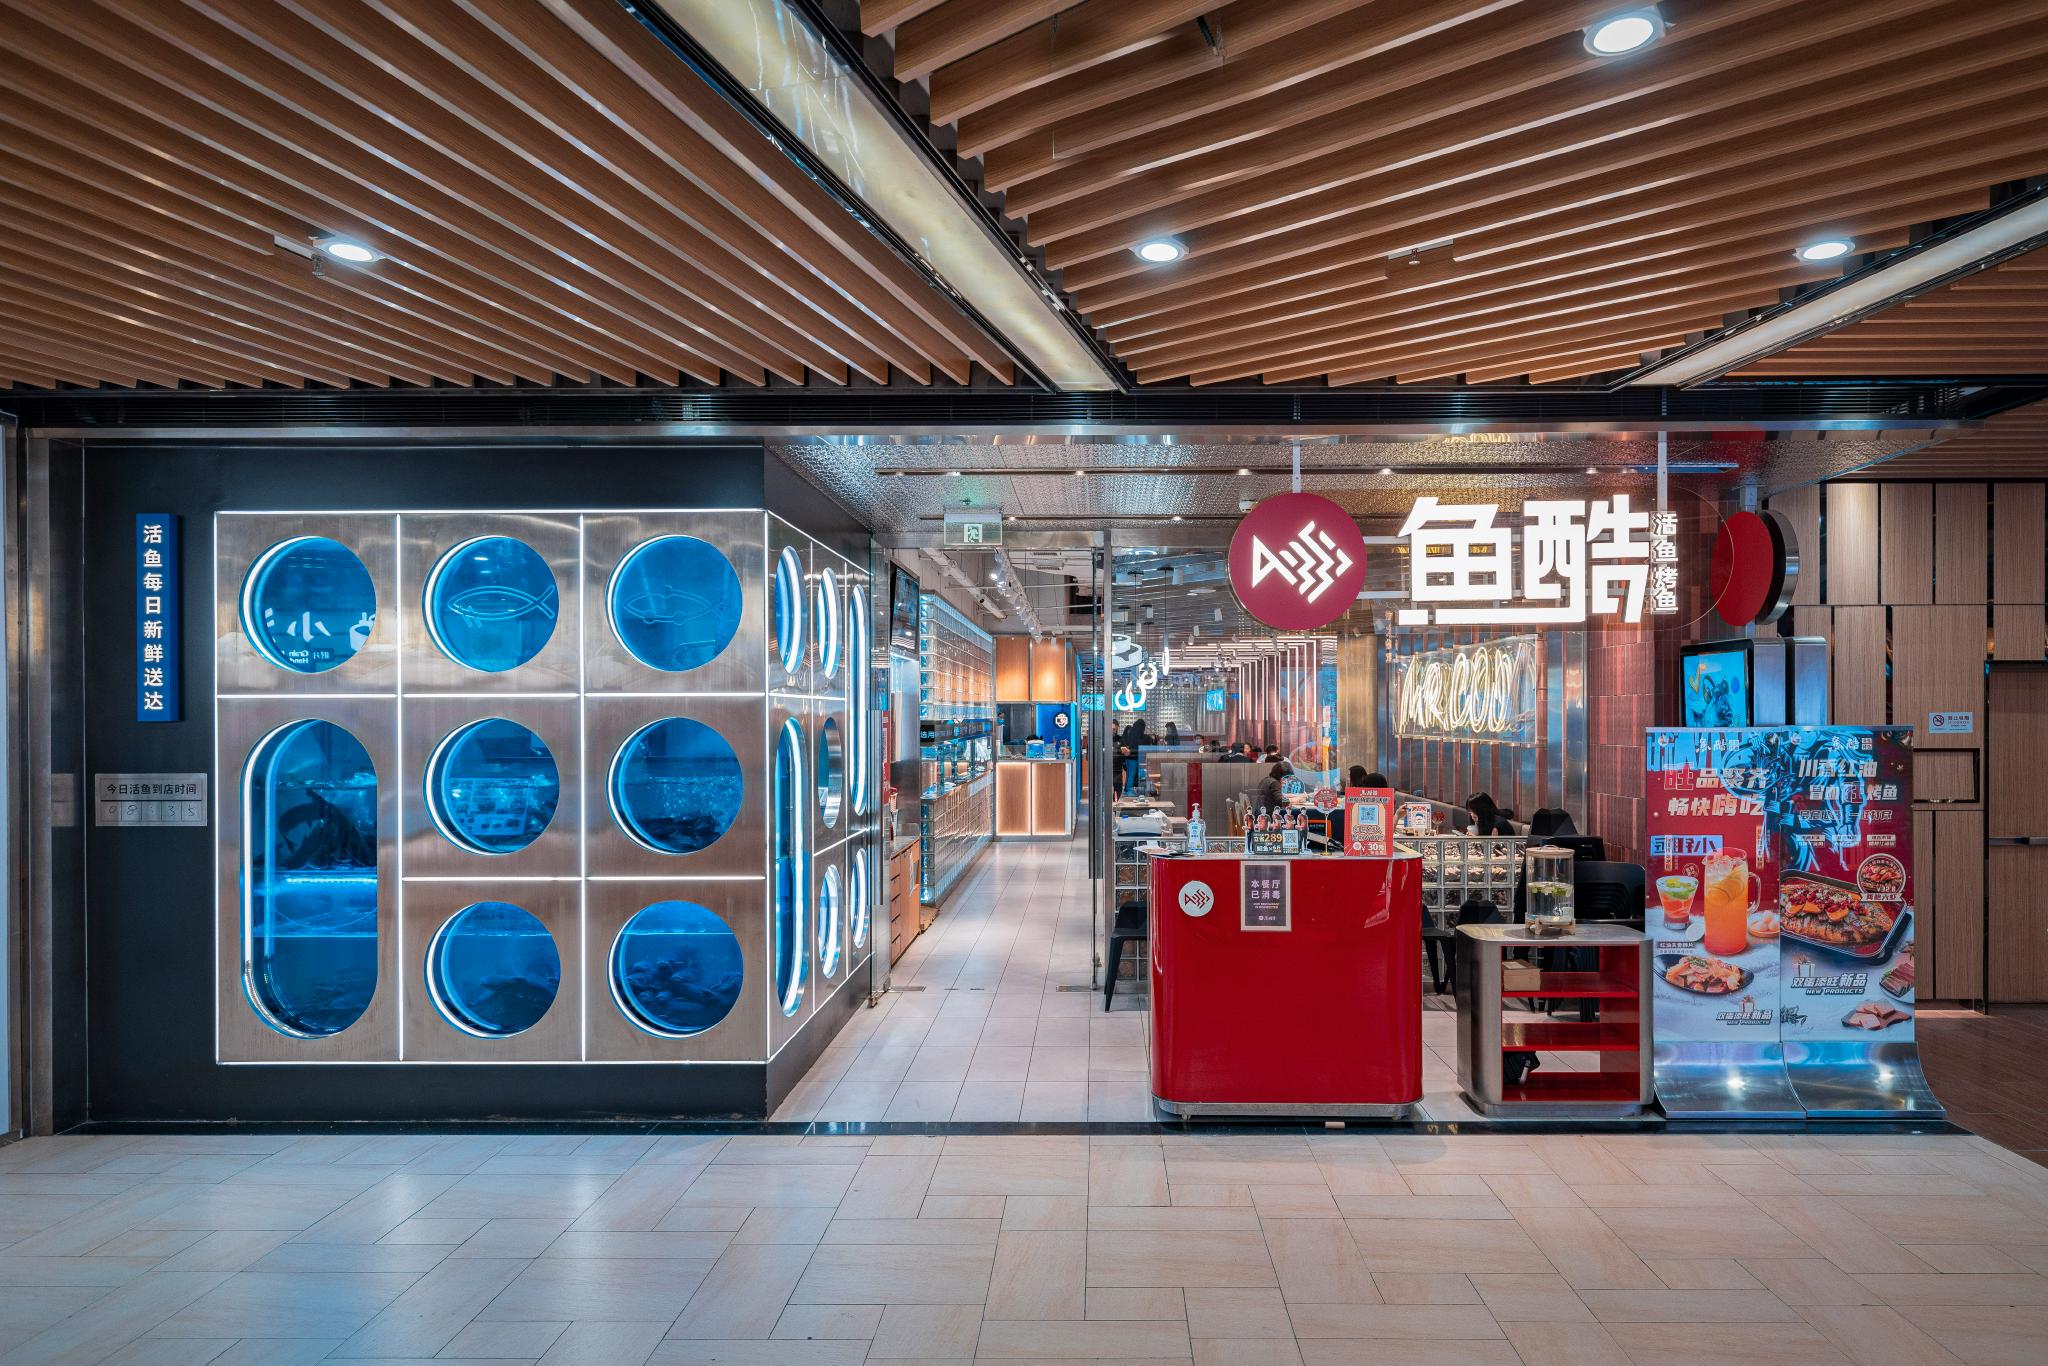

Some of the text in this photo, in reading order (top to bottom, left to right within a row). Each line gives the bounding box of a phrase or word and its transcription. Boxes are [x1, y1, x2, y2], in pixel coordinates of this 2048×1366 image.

[1398, 494, 1650, 626] 鱼酷
[1653, 512, 1678, 611] 活鱼烤鱼
[143, 524, 164, 711] 活鱼每日新鲜送达
[1798, 759, 1878, 777] 川香红油
[107, 784, 197, 795] 今日活鱼到店时间
[1667, 794, 1767, 816] 畅快嗨吃
[1251, 879, 1281, 889] 本餐厅
[1251, 890, 1281, 899] 已消毒
